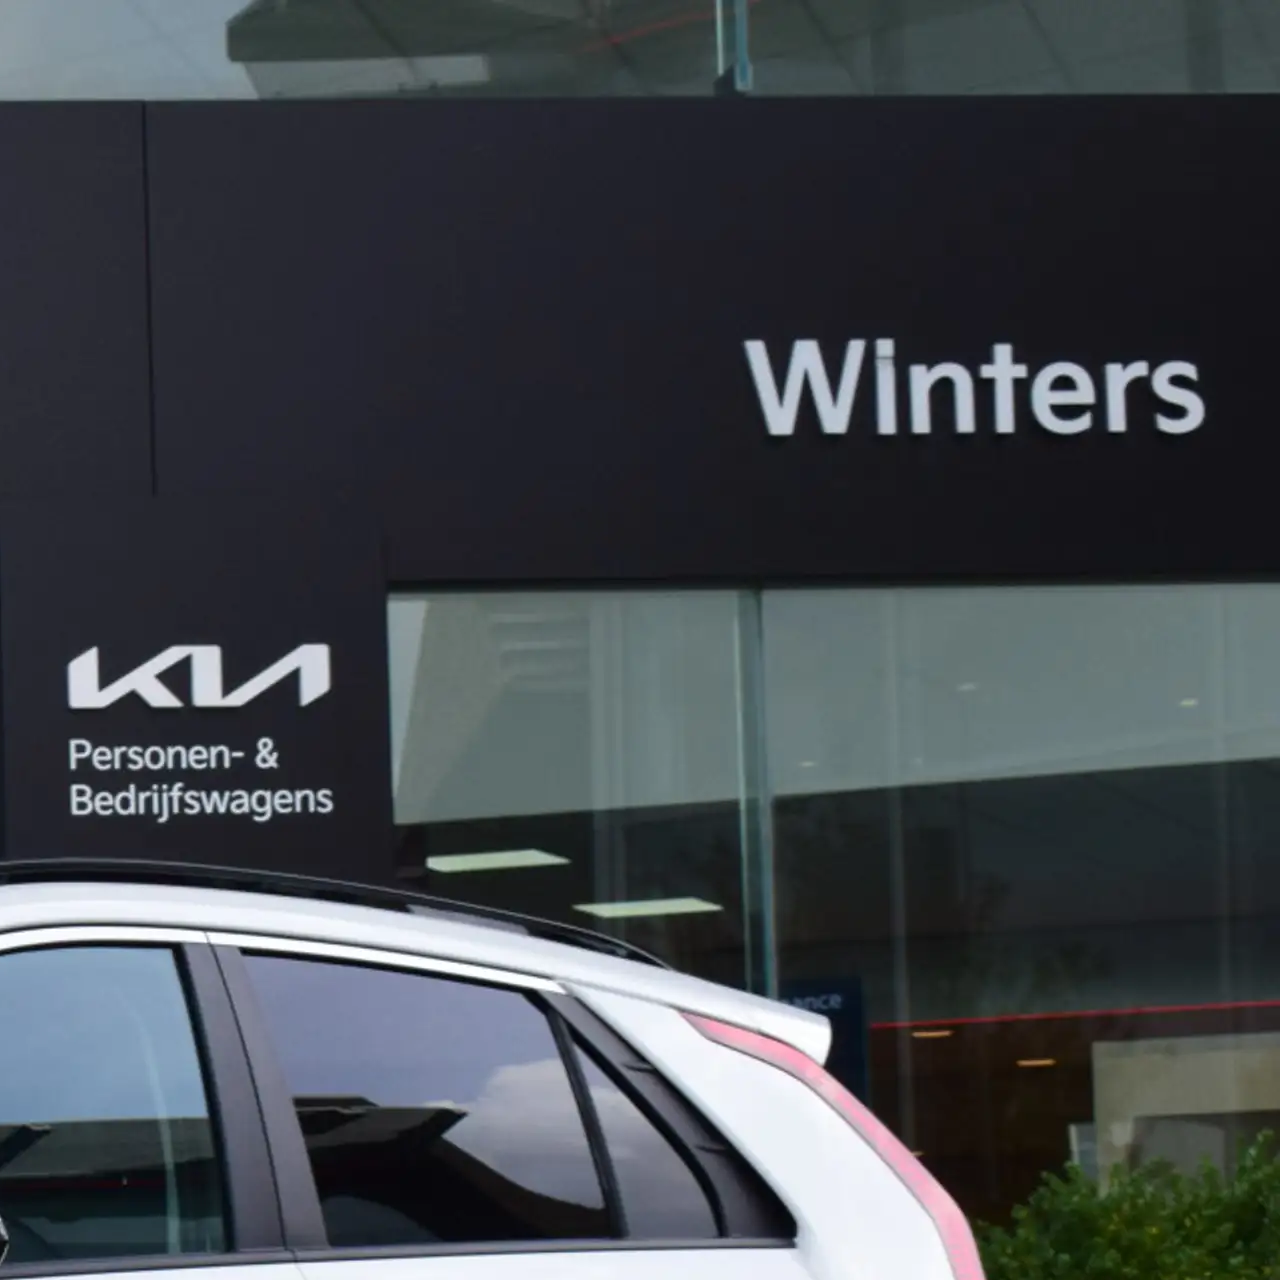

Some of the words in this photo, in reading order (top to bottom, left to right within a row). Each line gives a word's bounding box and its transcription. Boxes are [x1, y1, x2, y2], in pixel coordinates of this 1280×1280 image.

[743, 337, 1206, 436] Winters
[66, 643, 332, 709] KIA
[68, 738, 245, 771] Personen-
[254, 736, 279, 770] &
[69, 781, 335, 823] Bedrijfswagens
